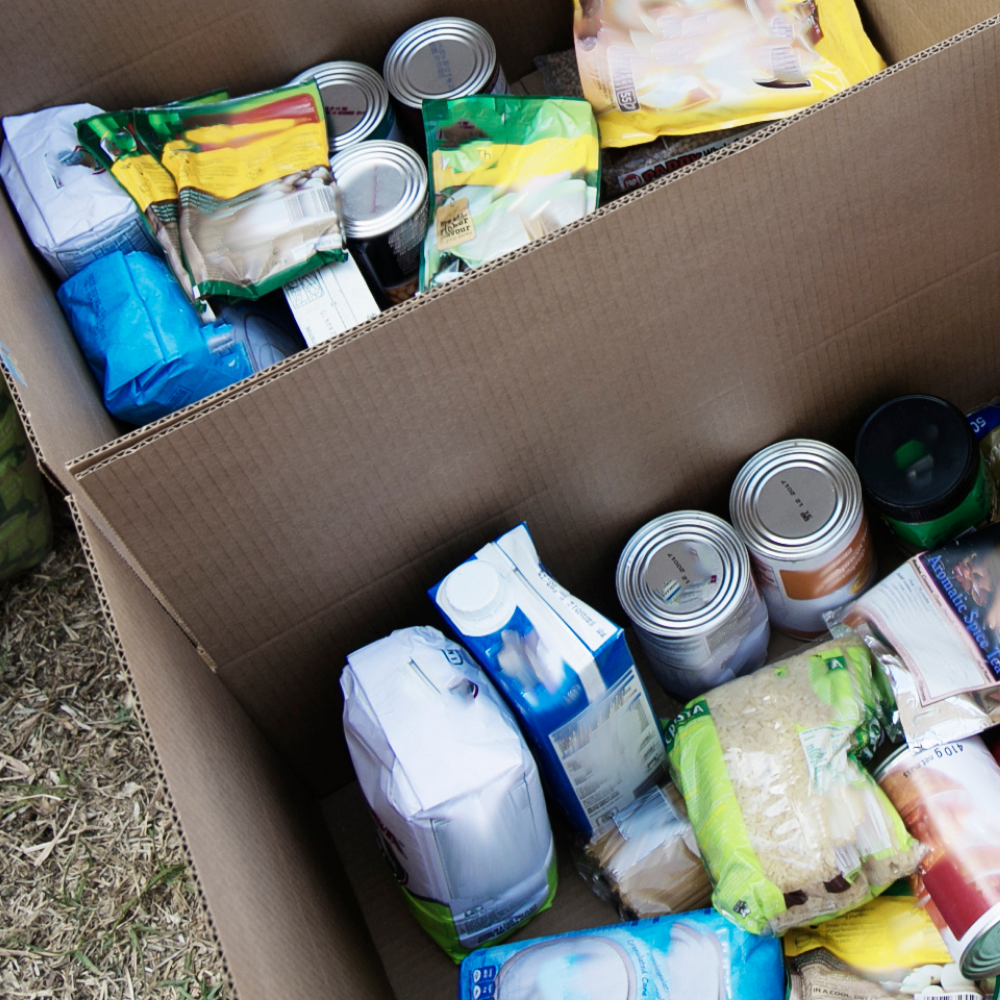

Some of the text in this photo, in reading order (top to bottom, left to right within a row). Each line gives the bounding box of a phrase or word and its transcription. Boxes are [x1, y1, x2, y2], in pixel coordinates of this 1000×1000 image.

[927, 554, 968, 614] Aromatic
[963, 606, 990, 650] Spice
[812, 986, 822, 994] IN
